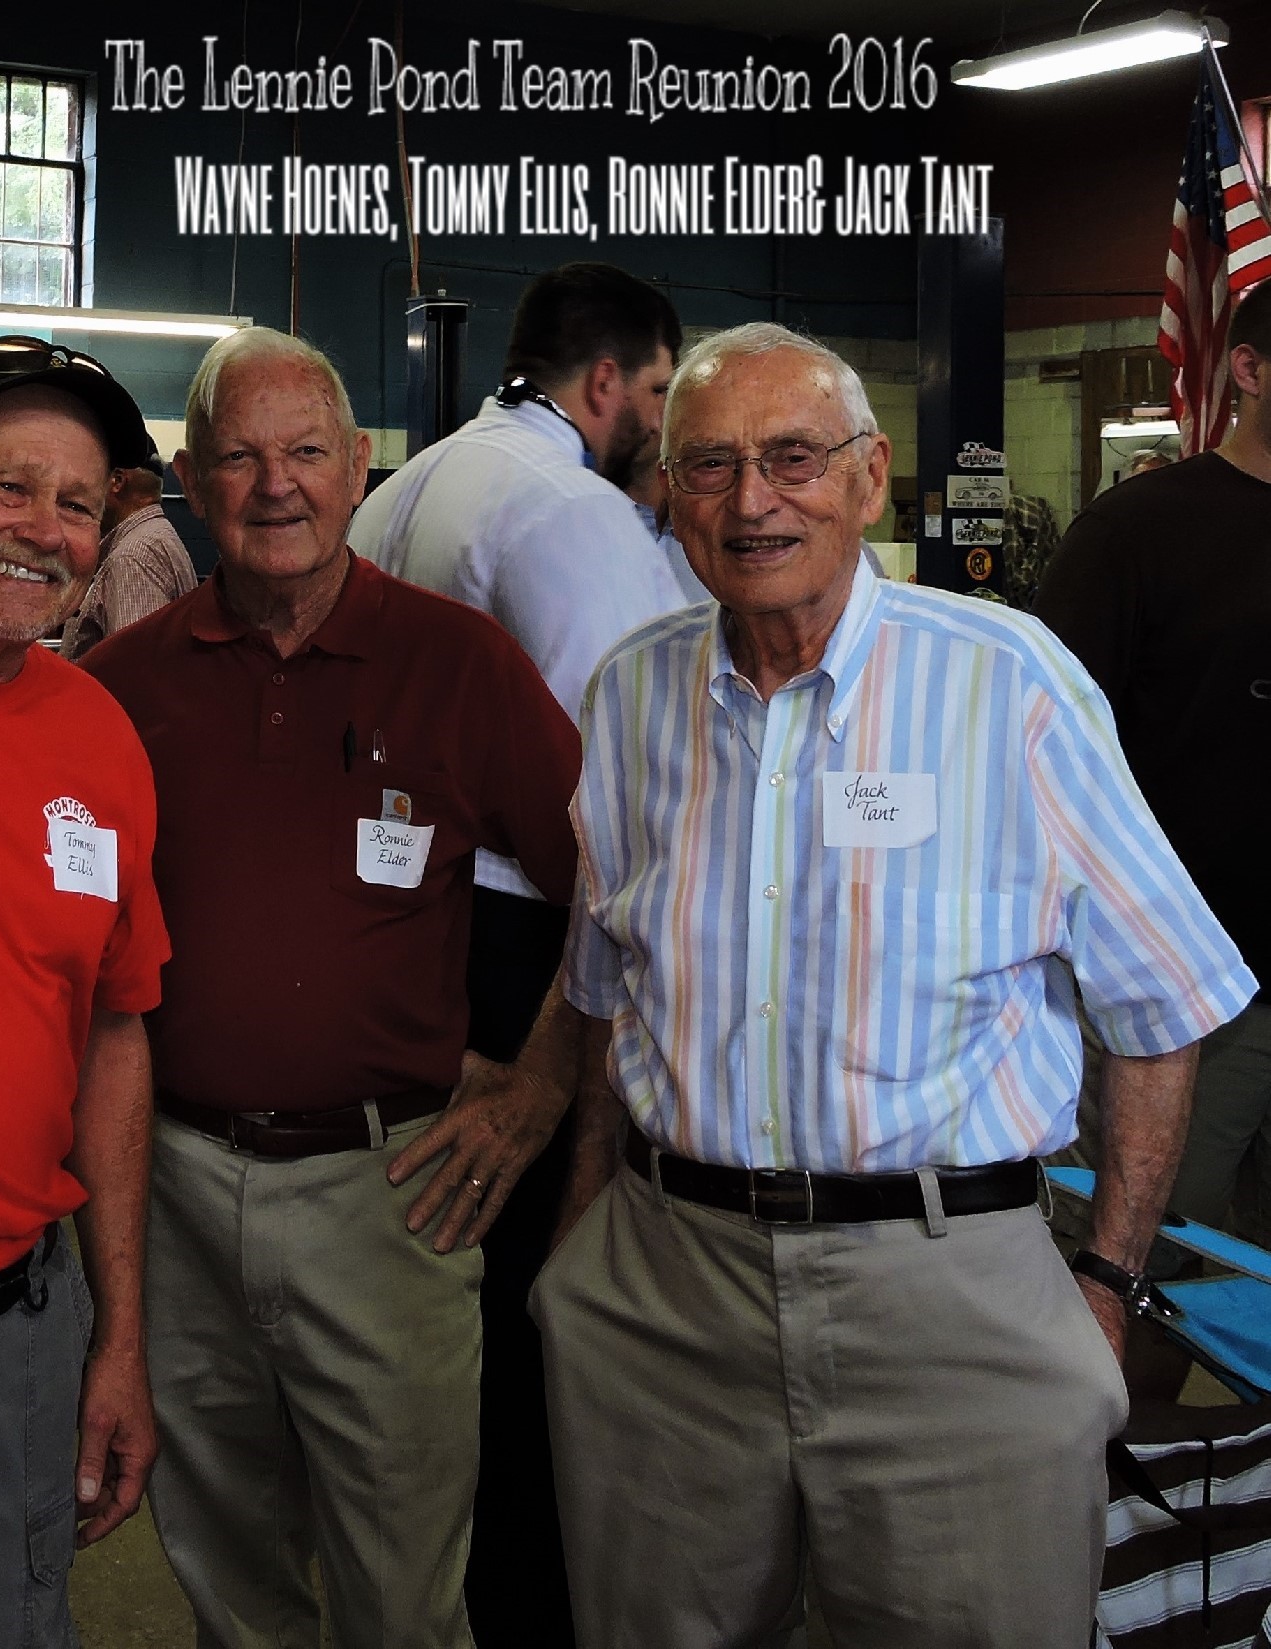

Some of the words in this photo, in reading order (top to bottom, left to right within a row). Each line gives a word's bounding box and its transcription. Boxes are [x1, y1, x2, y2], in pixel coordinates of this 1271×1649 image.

[844, 775, 888, 809] Jack
[857, 800, 899, 821] Tant
[64, 832, 96, 859] Tommy
[370, 825, 414, 847] Ronnie
[68, 855, 93, 876] Ellis
[377, 849, 411, 867] Elder
